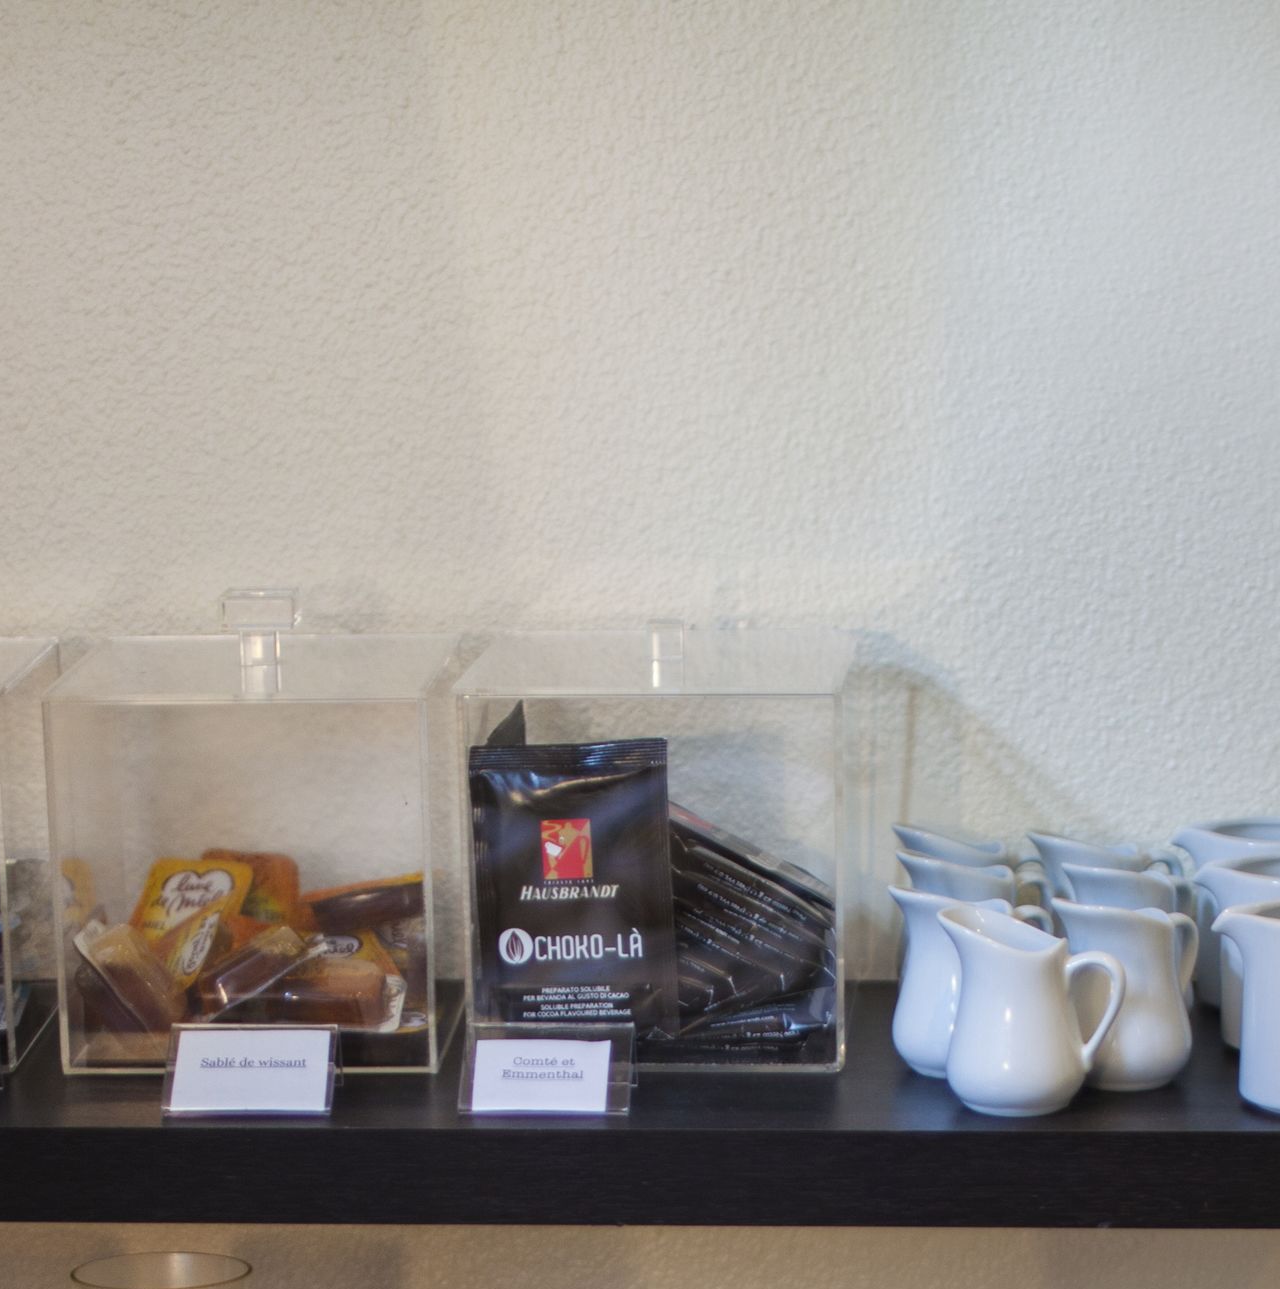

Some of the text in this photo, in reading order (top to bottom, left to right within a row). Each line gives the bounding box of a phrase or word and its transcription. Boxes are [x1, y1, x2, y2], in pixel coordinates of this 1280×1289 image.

[520, 884, 620, 900] HAUSBRANDT
[534, 926, 644, 961] CHOKO-LÀ
[200, 1057, 307, 1069] Sablé de wissant
[513, 1057, 575, 1066] Comté et
[502, 1069, 584, 1080] Emmenthal
